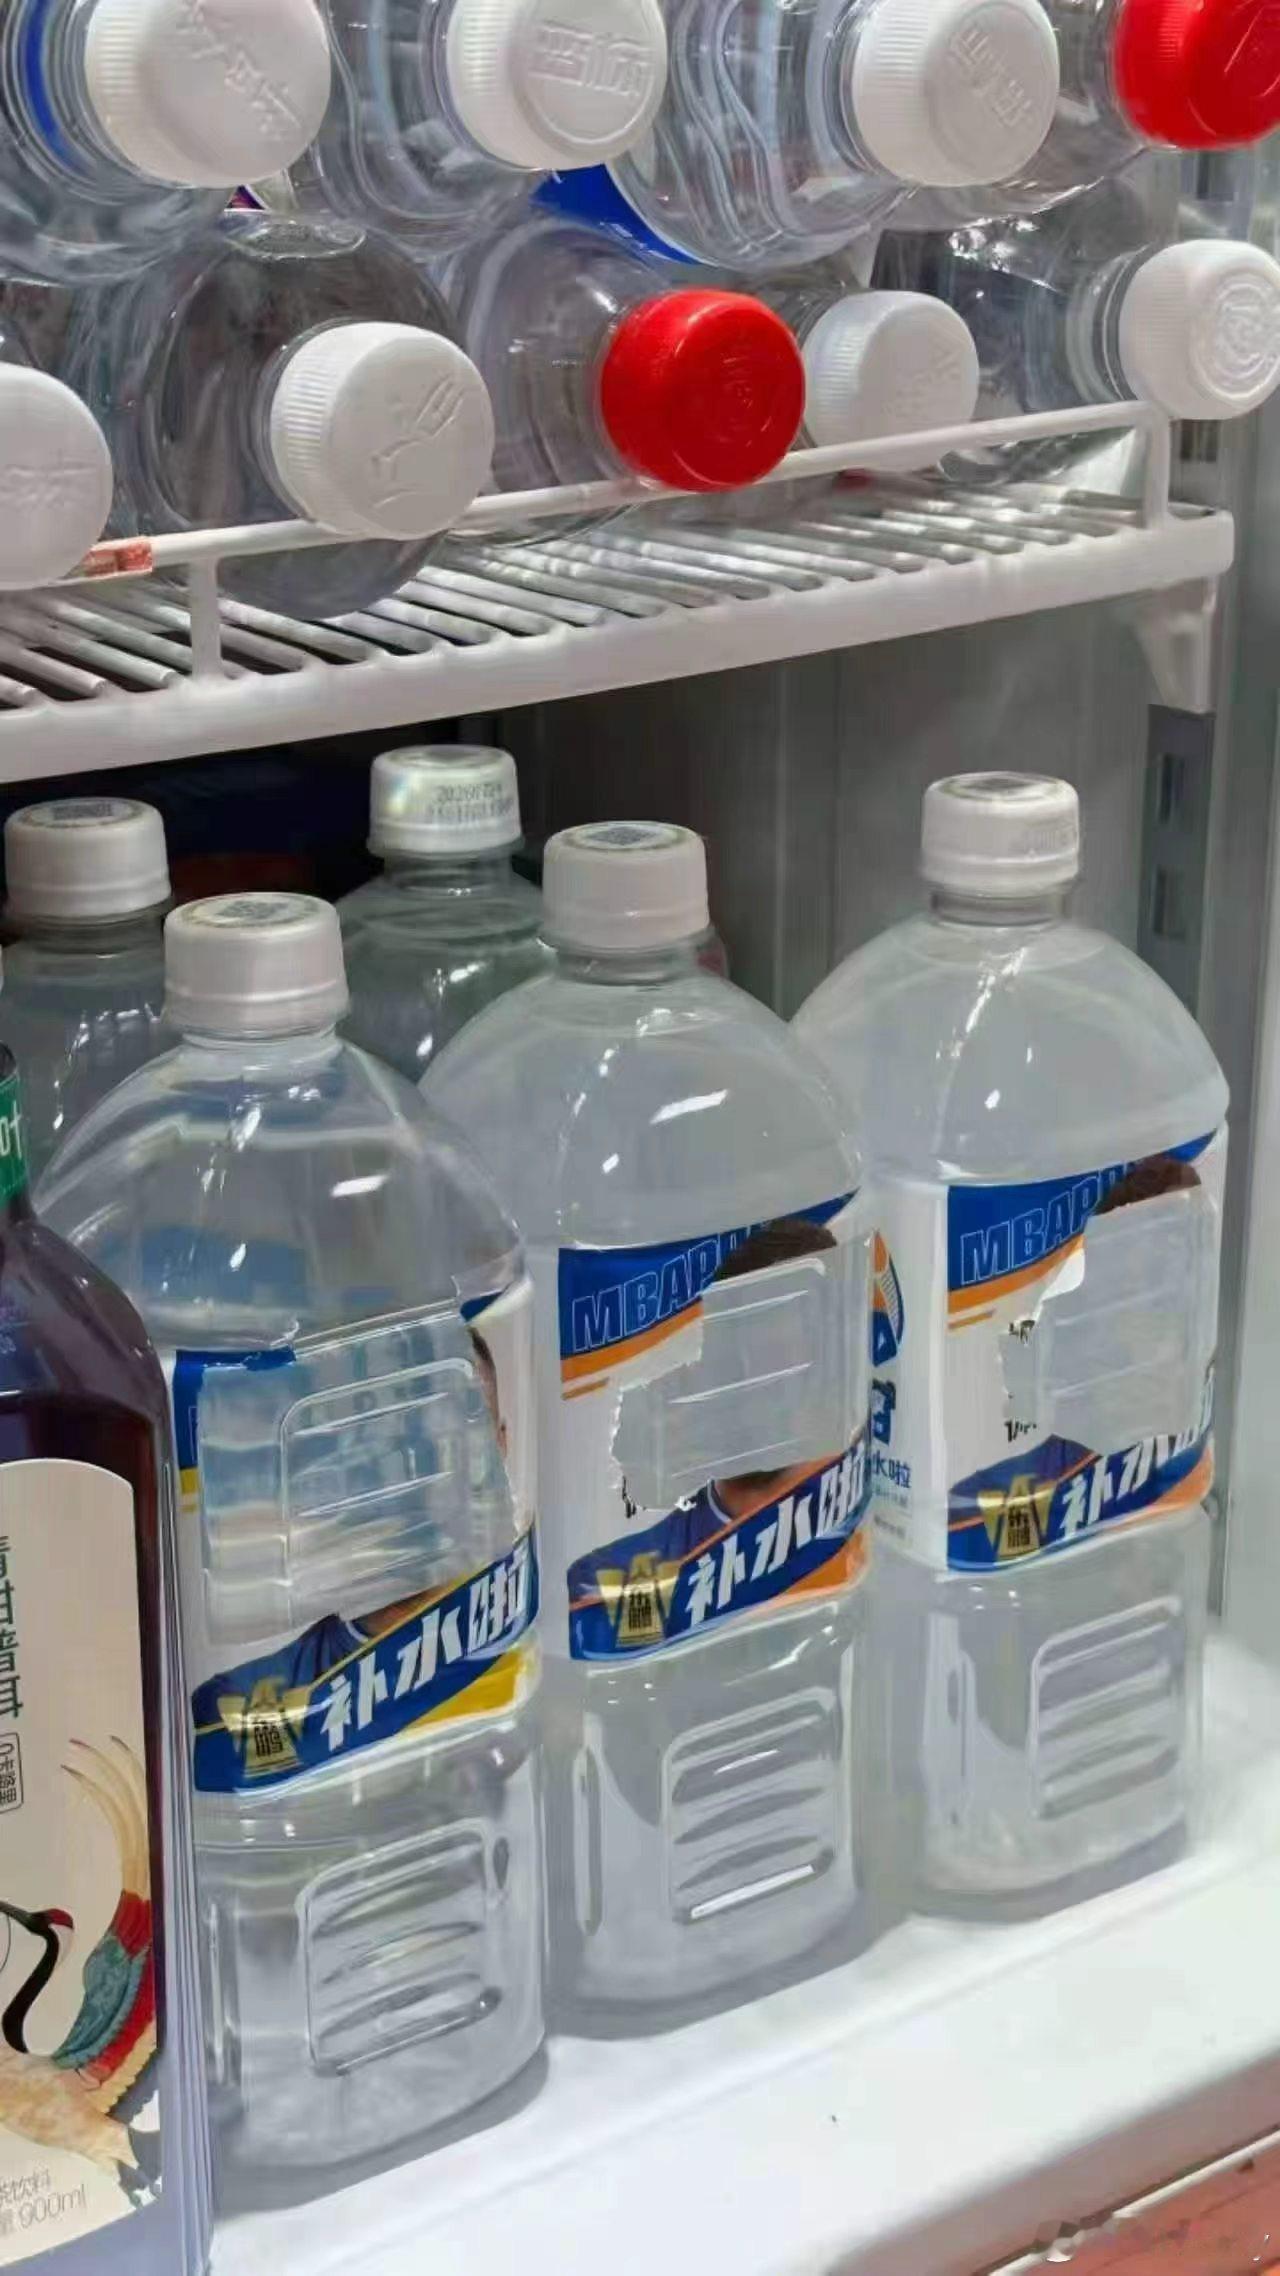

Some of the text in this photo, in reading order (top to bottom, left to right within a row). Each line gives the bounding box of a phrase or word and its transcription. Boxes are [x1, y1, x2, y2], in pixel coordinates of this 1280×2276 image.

[871, 1450, 911, 1489] 水啦
[320, 1537, 529, 1751] 补水啦
